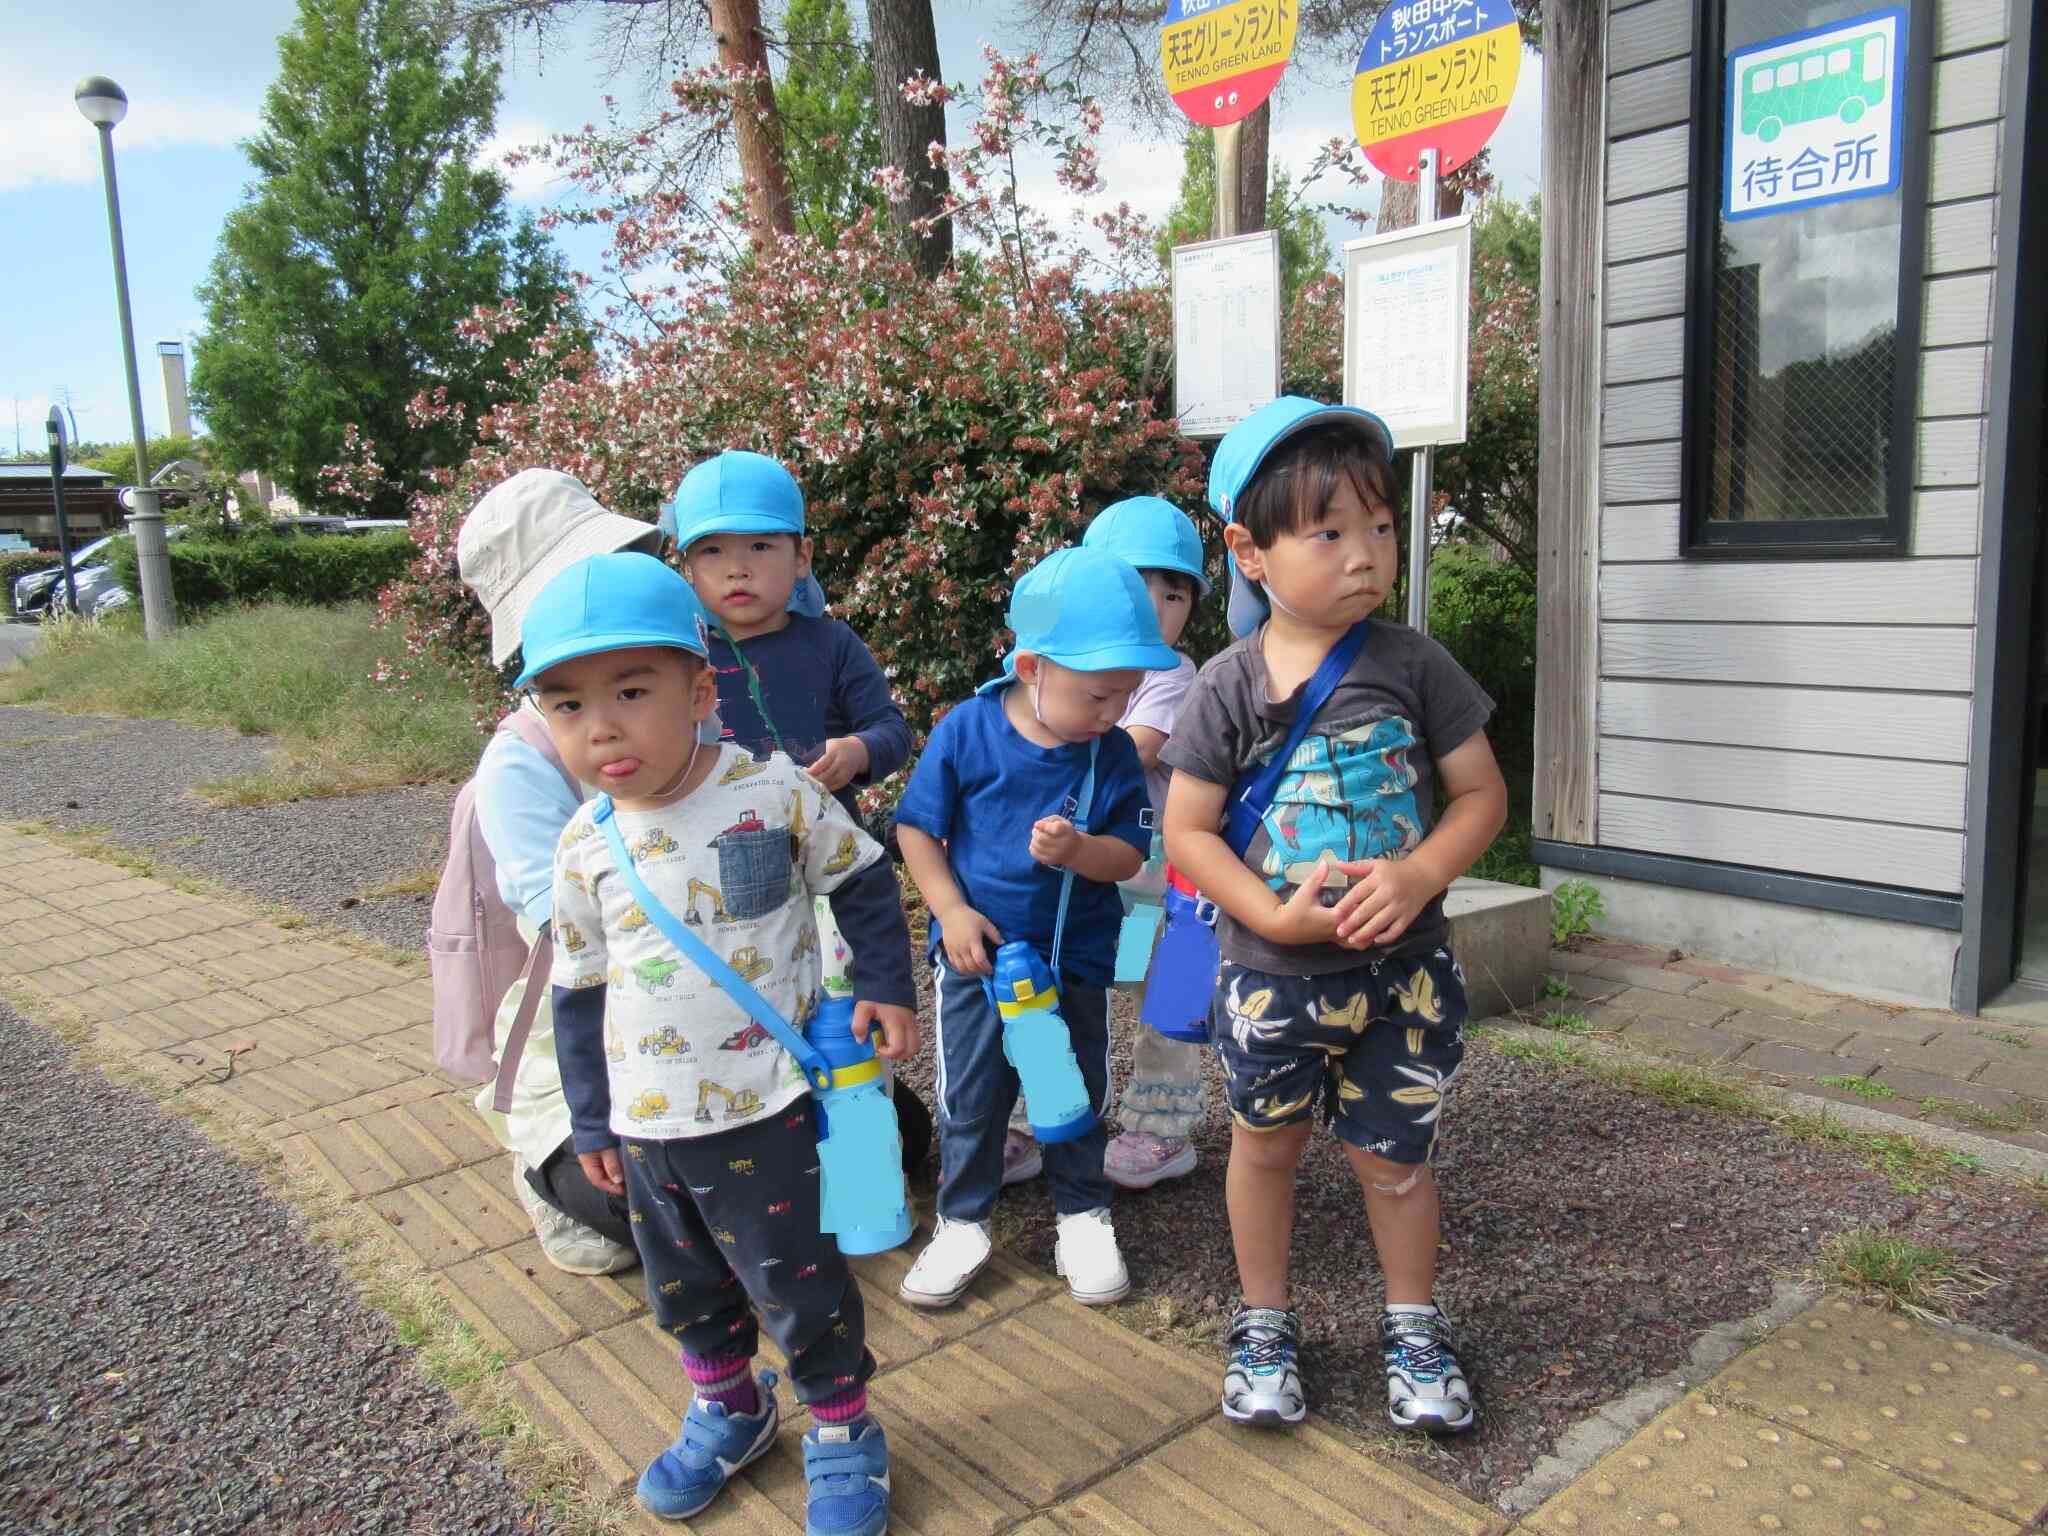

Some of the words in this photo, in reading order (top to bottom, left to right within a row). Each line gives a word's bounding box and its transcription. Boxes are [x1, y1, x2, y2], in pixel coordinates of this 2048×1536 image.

[1168, 0, 1289, 70] 天王グリーンランド
[1175, 63, 1210, 84] TENNO
[1212, 51, 1250, 73] GREEN
[1251, 41, 1282, 61] LAND
[1380, 6, 1489, 63] トランスポート
[1370, 38, 1498, 116] 天王グリーンランド
[1370, 110, 1412, 137] TENNO
[1414, 96, 1458, 124] GREEN
[1460, 84, 1499, 112] LAND
[1742, 132, 1879, 202] 待合所
